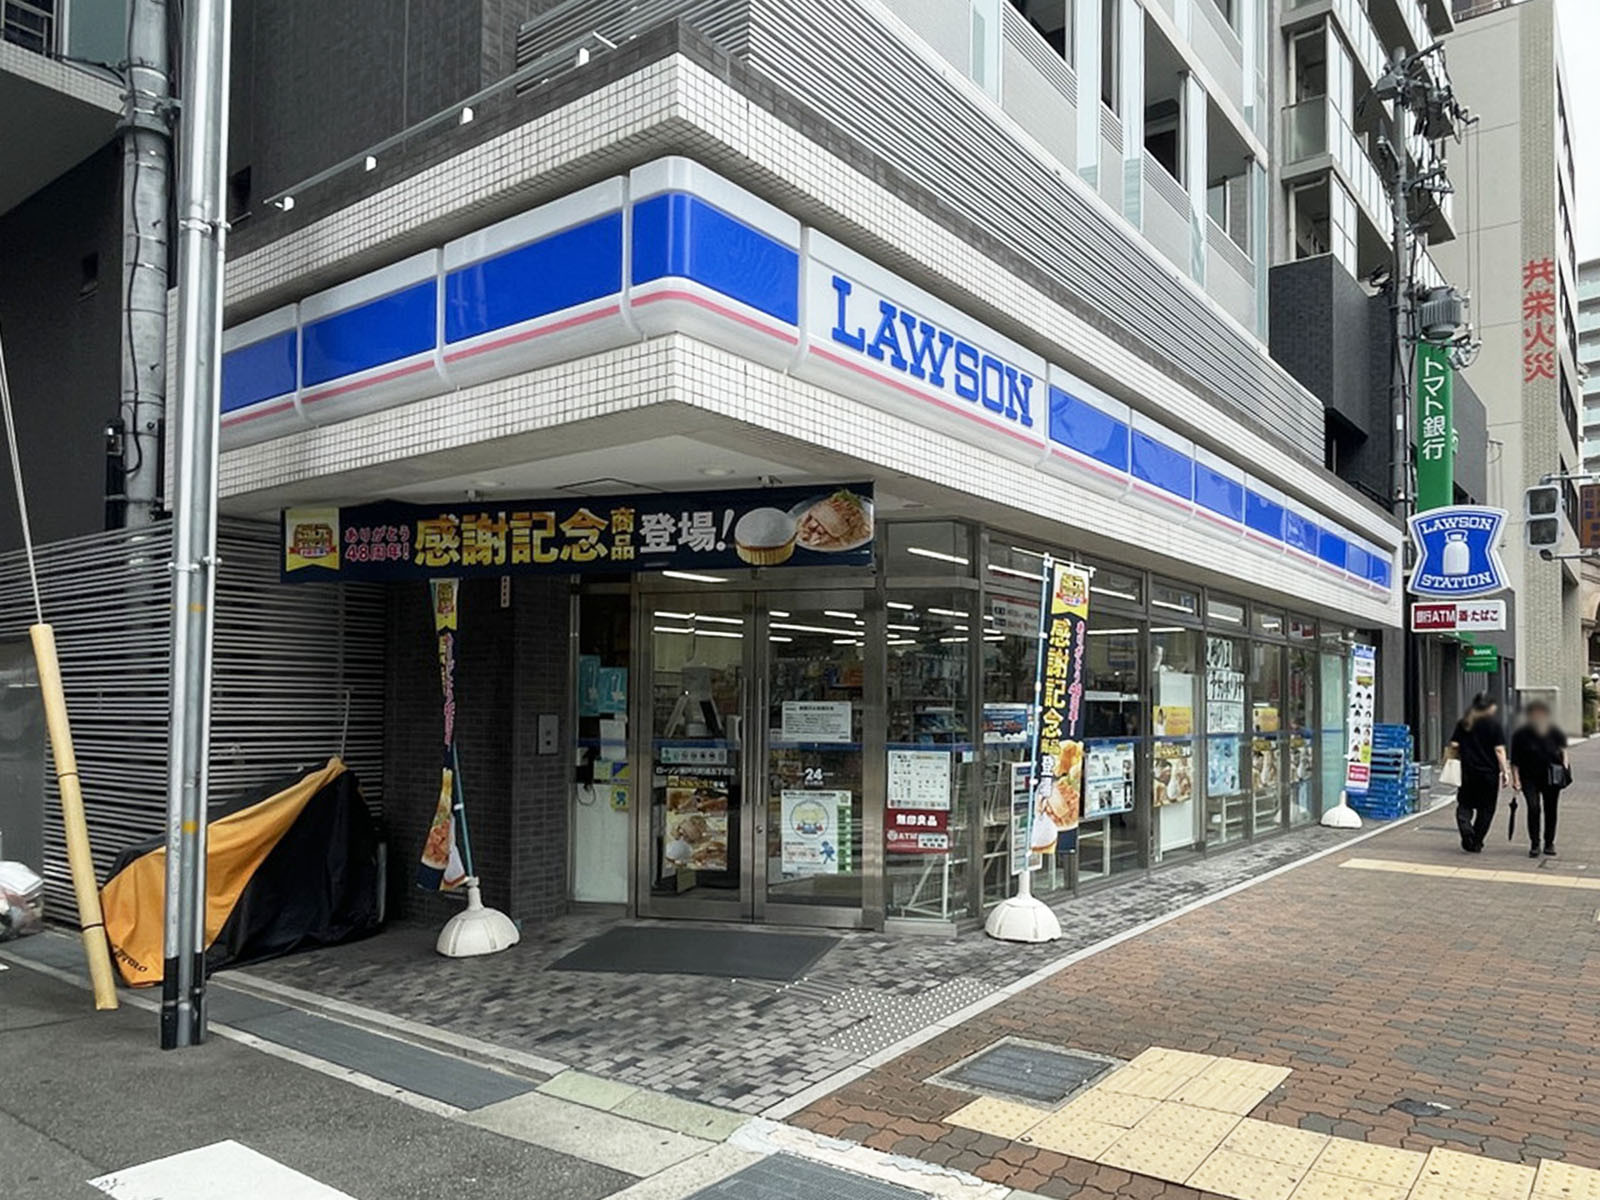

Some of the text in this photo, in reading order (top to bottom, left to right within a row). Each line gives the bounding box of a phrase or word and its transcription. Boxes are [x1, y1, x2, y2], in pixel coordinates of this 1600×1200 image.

[1523, 258, 1556, 382] 共栄火災
[832, 275, 1033, 428] LAWSON
[1422, 357, 1446, 460] トマト銀行
[1420, 516, 1493, 534] LAWSON
[1420, 572, 1492, 588] STATION
[804, 767, 823, 780] 24
